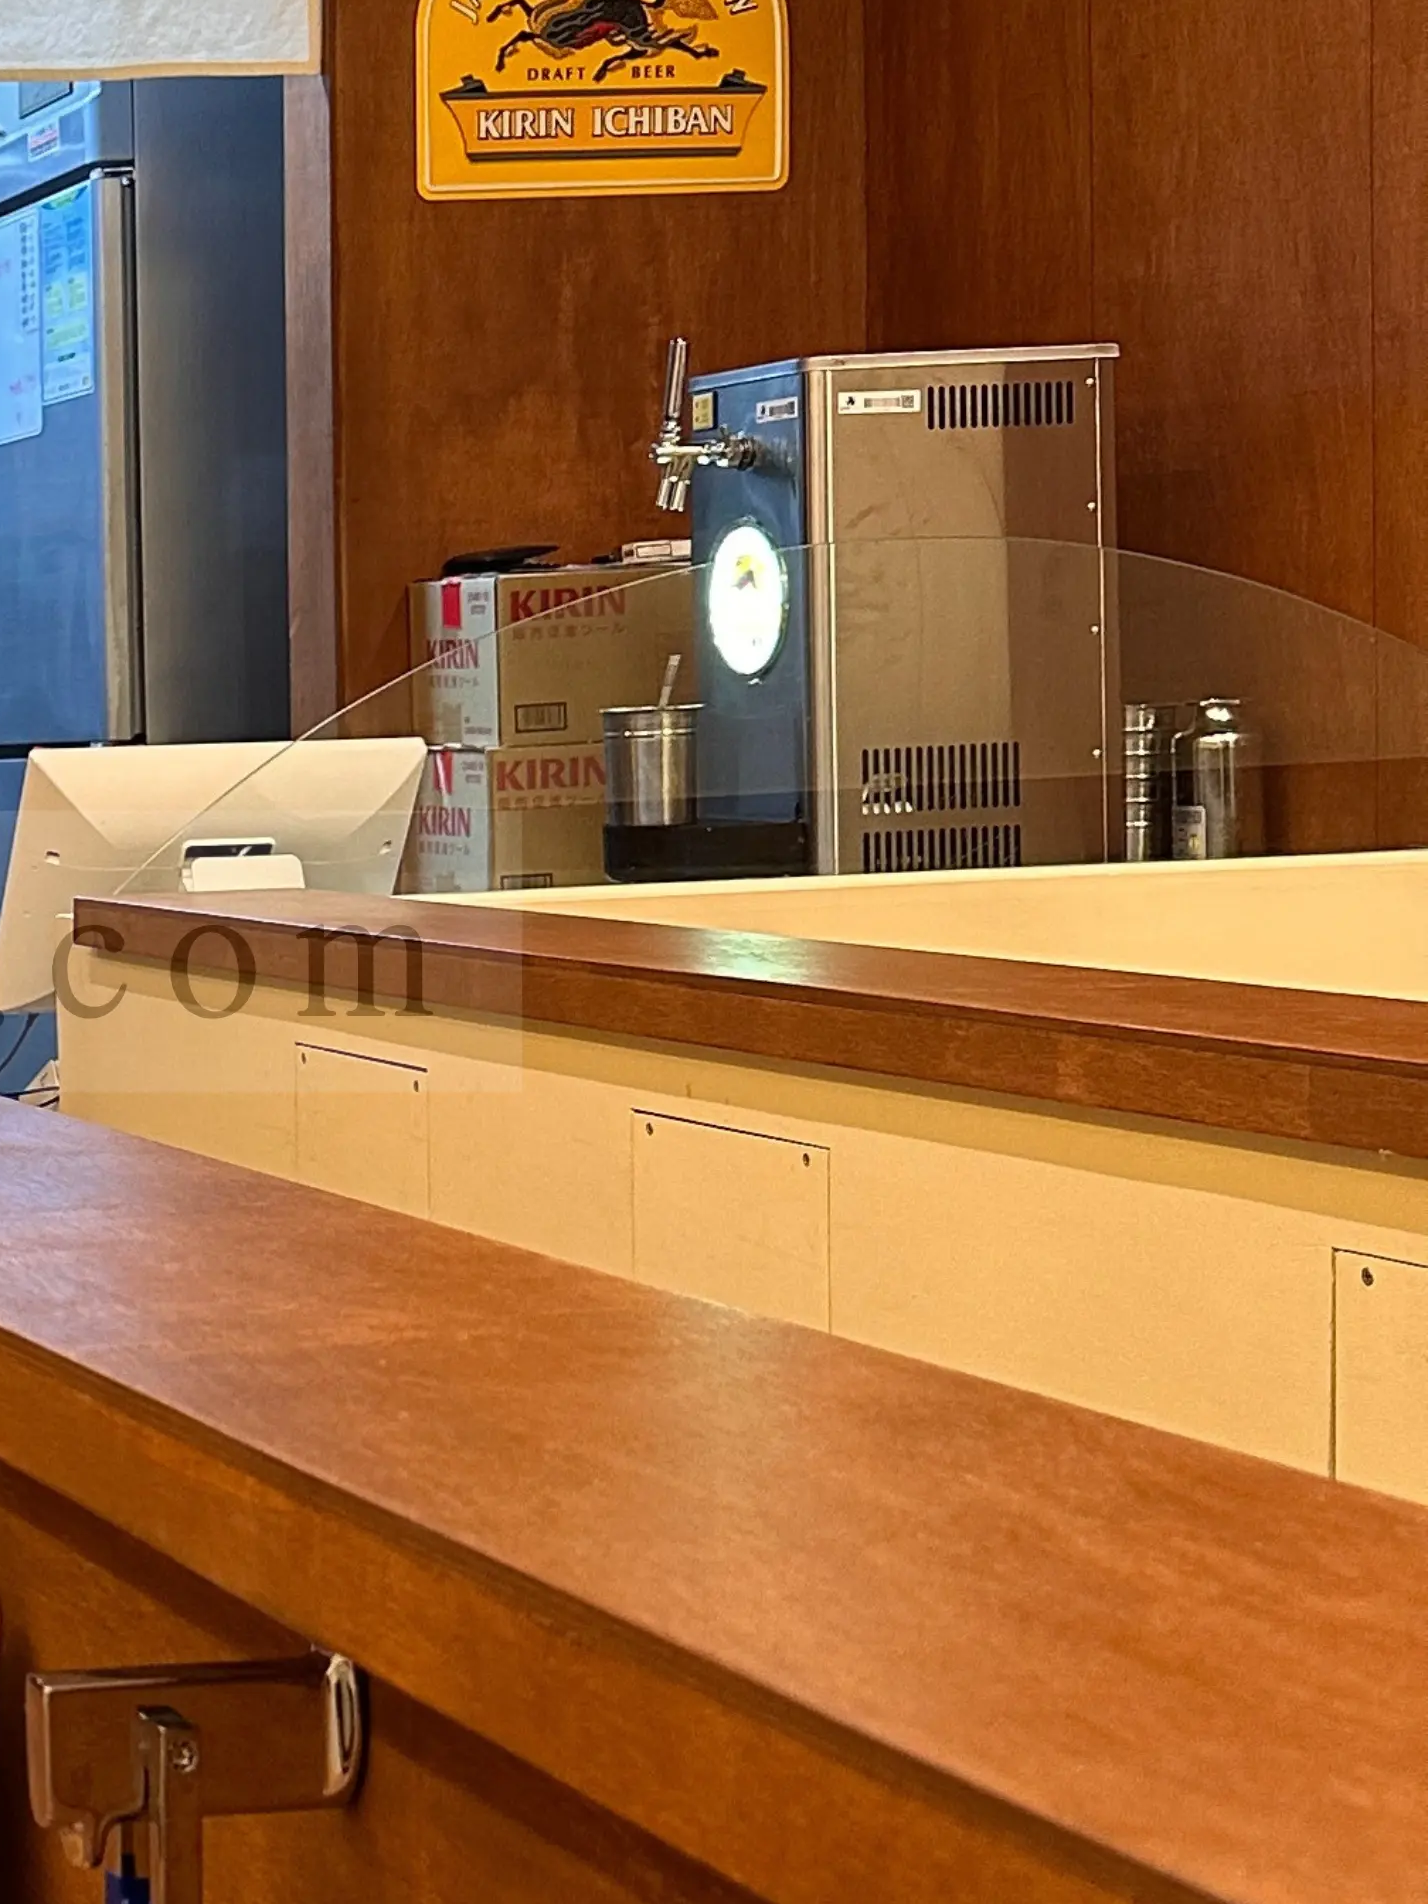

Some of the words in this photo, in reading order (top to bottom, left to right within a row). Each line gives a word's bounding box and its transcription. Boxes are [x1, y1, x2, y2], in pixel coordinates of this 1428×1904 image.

[526, 67, 587, 81] DRAFT
[631, 65, 677, 79] BEER
[476, 107, 575, 141] KIRIN
[591, 104, 734, 139] ICHIBAN
[510, 585, 626, 623] KIRIN
[427, 639, 480, 670] KIRIN
[497, 756, 607, 791] KIRIN
[419, 806, 471, 838] KIRIN
